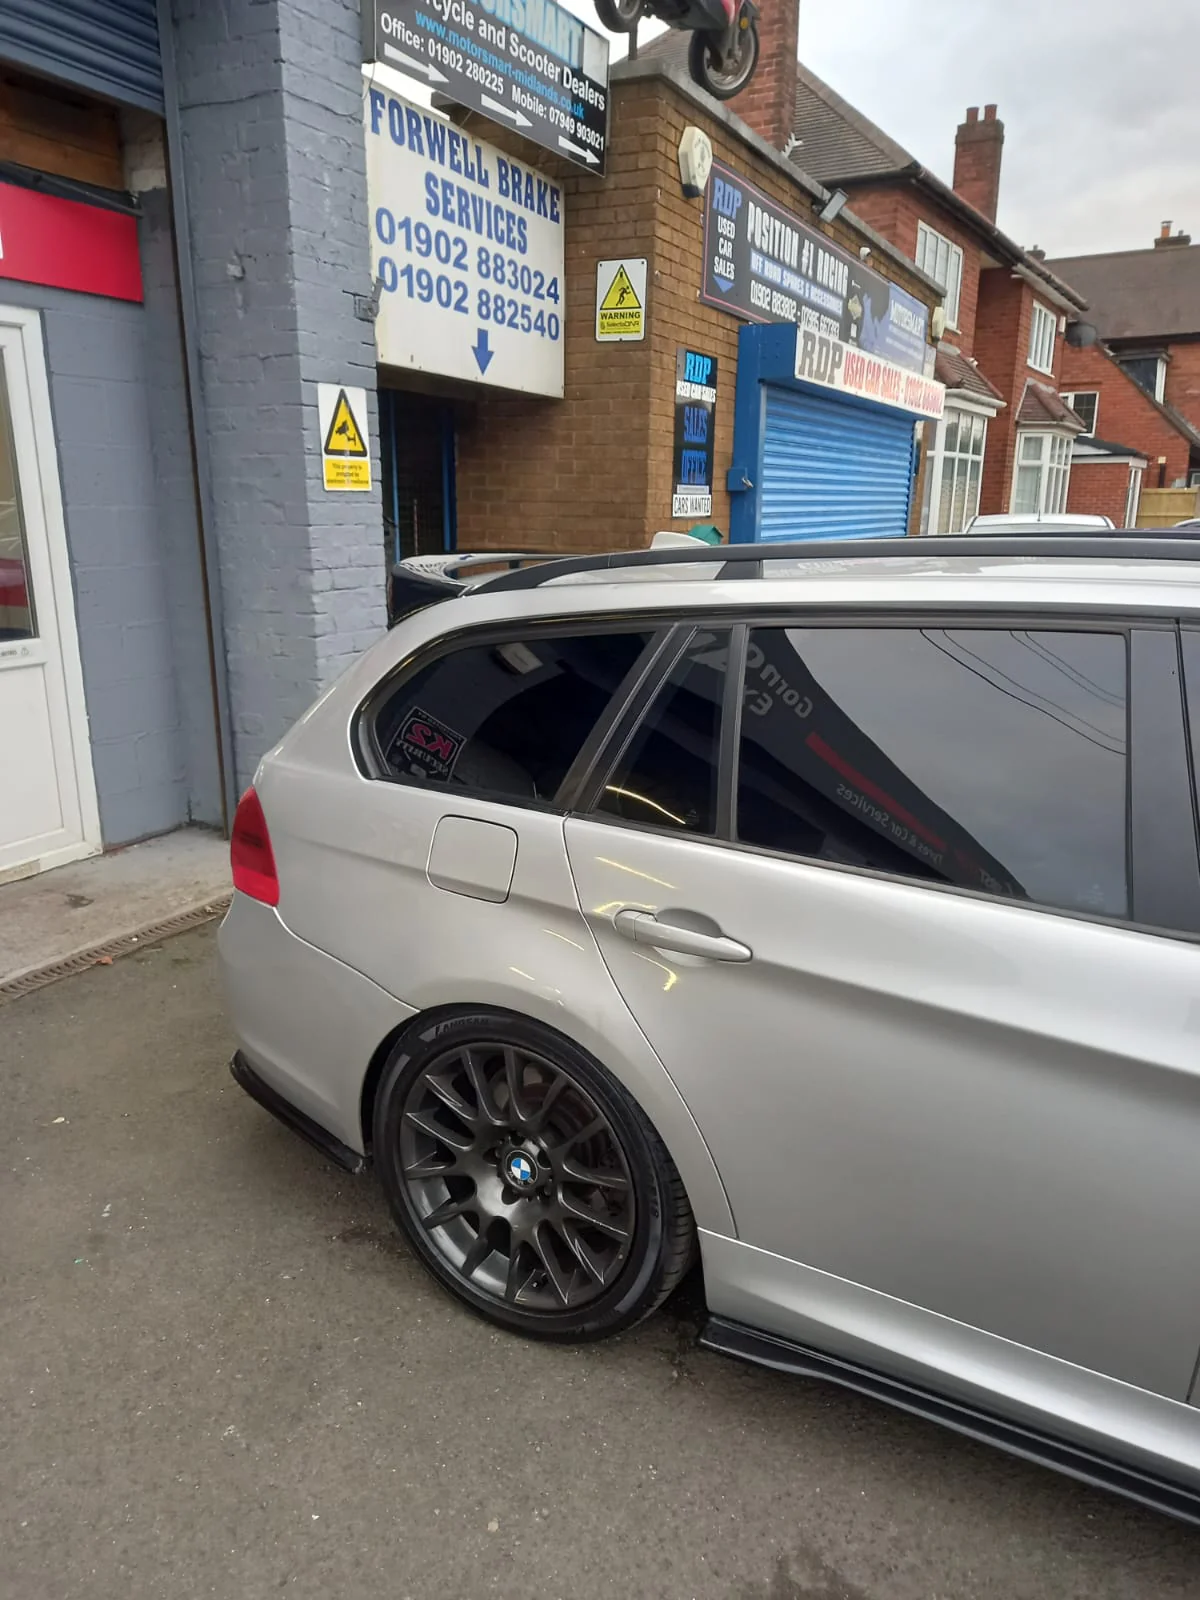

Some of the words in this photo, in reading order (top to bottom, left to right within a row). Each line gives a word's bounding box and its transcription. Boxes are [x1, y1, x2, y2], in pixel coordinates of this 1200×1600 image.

[415, 10, 585, 119] www.motorsmart-midlands.co.uk
[426, 0, 475, 31] cycle
[478, 18, 506, 51] and
[509, 34, 561, 81] Scooter
[562, 67, 606, 112] Dealers
[380, 12, 425, 52] Office:
[427, 37, 463, 74] 01902
[465, 59, 505, 95] 280225
[511, 84, 548, 119] Mobile:
[549, 107, 575, 137] 07949
[576, 123, 605, 152] 903021
[370, 88, 489, 189] FORWELL
[497, 155, 561, 225] BRAKE
[424, 171, 528, 255] SERVICES
[712, 177, 743, 220] RDP
[717, 215, 736, 240] USED
[718, 238, 733, 259] CAR
[375, 207, 469, 273] 01902
[476, 246, 560, 305] 883024
[713, 255, 735, 281] SALES
[747, 200, 799, 270] POSITION
[801, 239, 814, 279] #1
[816, 248, 849, 299] RACING
[378, 256, 469, 315] 01902
[477, 289, 560, 341] 882540
[600, 311, 641, 320] WARNING
[750, 279, 771, 311] 01902
[684, 352, 712, 384] RDP
[799, 330, 844, 384] RDP
[843, 351, 866, 390] USED
[865, 359, 882, 396] CAR
[881, 366, 902, 402] SALES
[684, 405, 708, 444] SALES
[681, 448, 707, 484] OFFICE
[674, 497, 689, 514] CARS
[689, 497, 711, 514] WANTED
